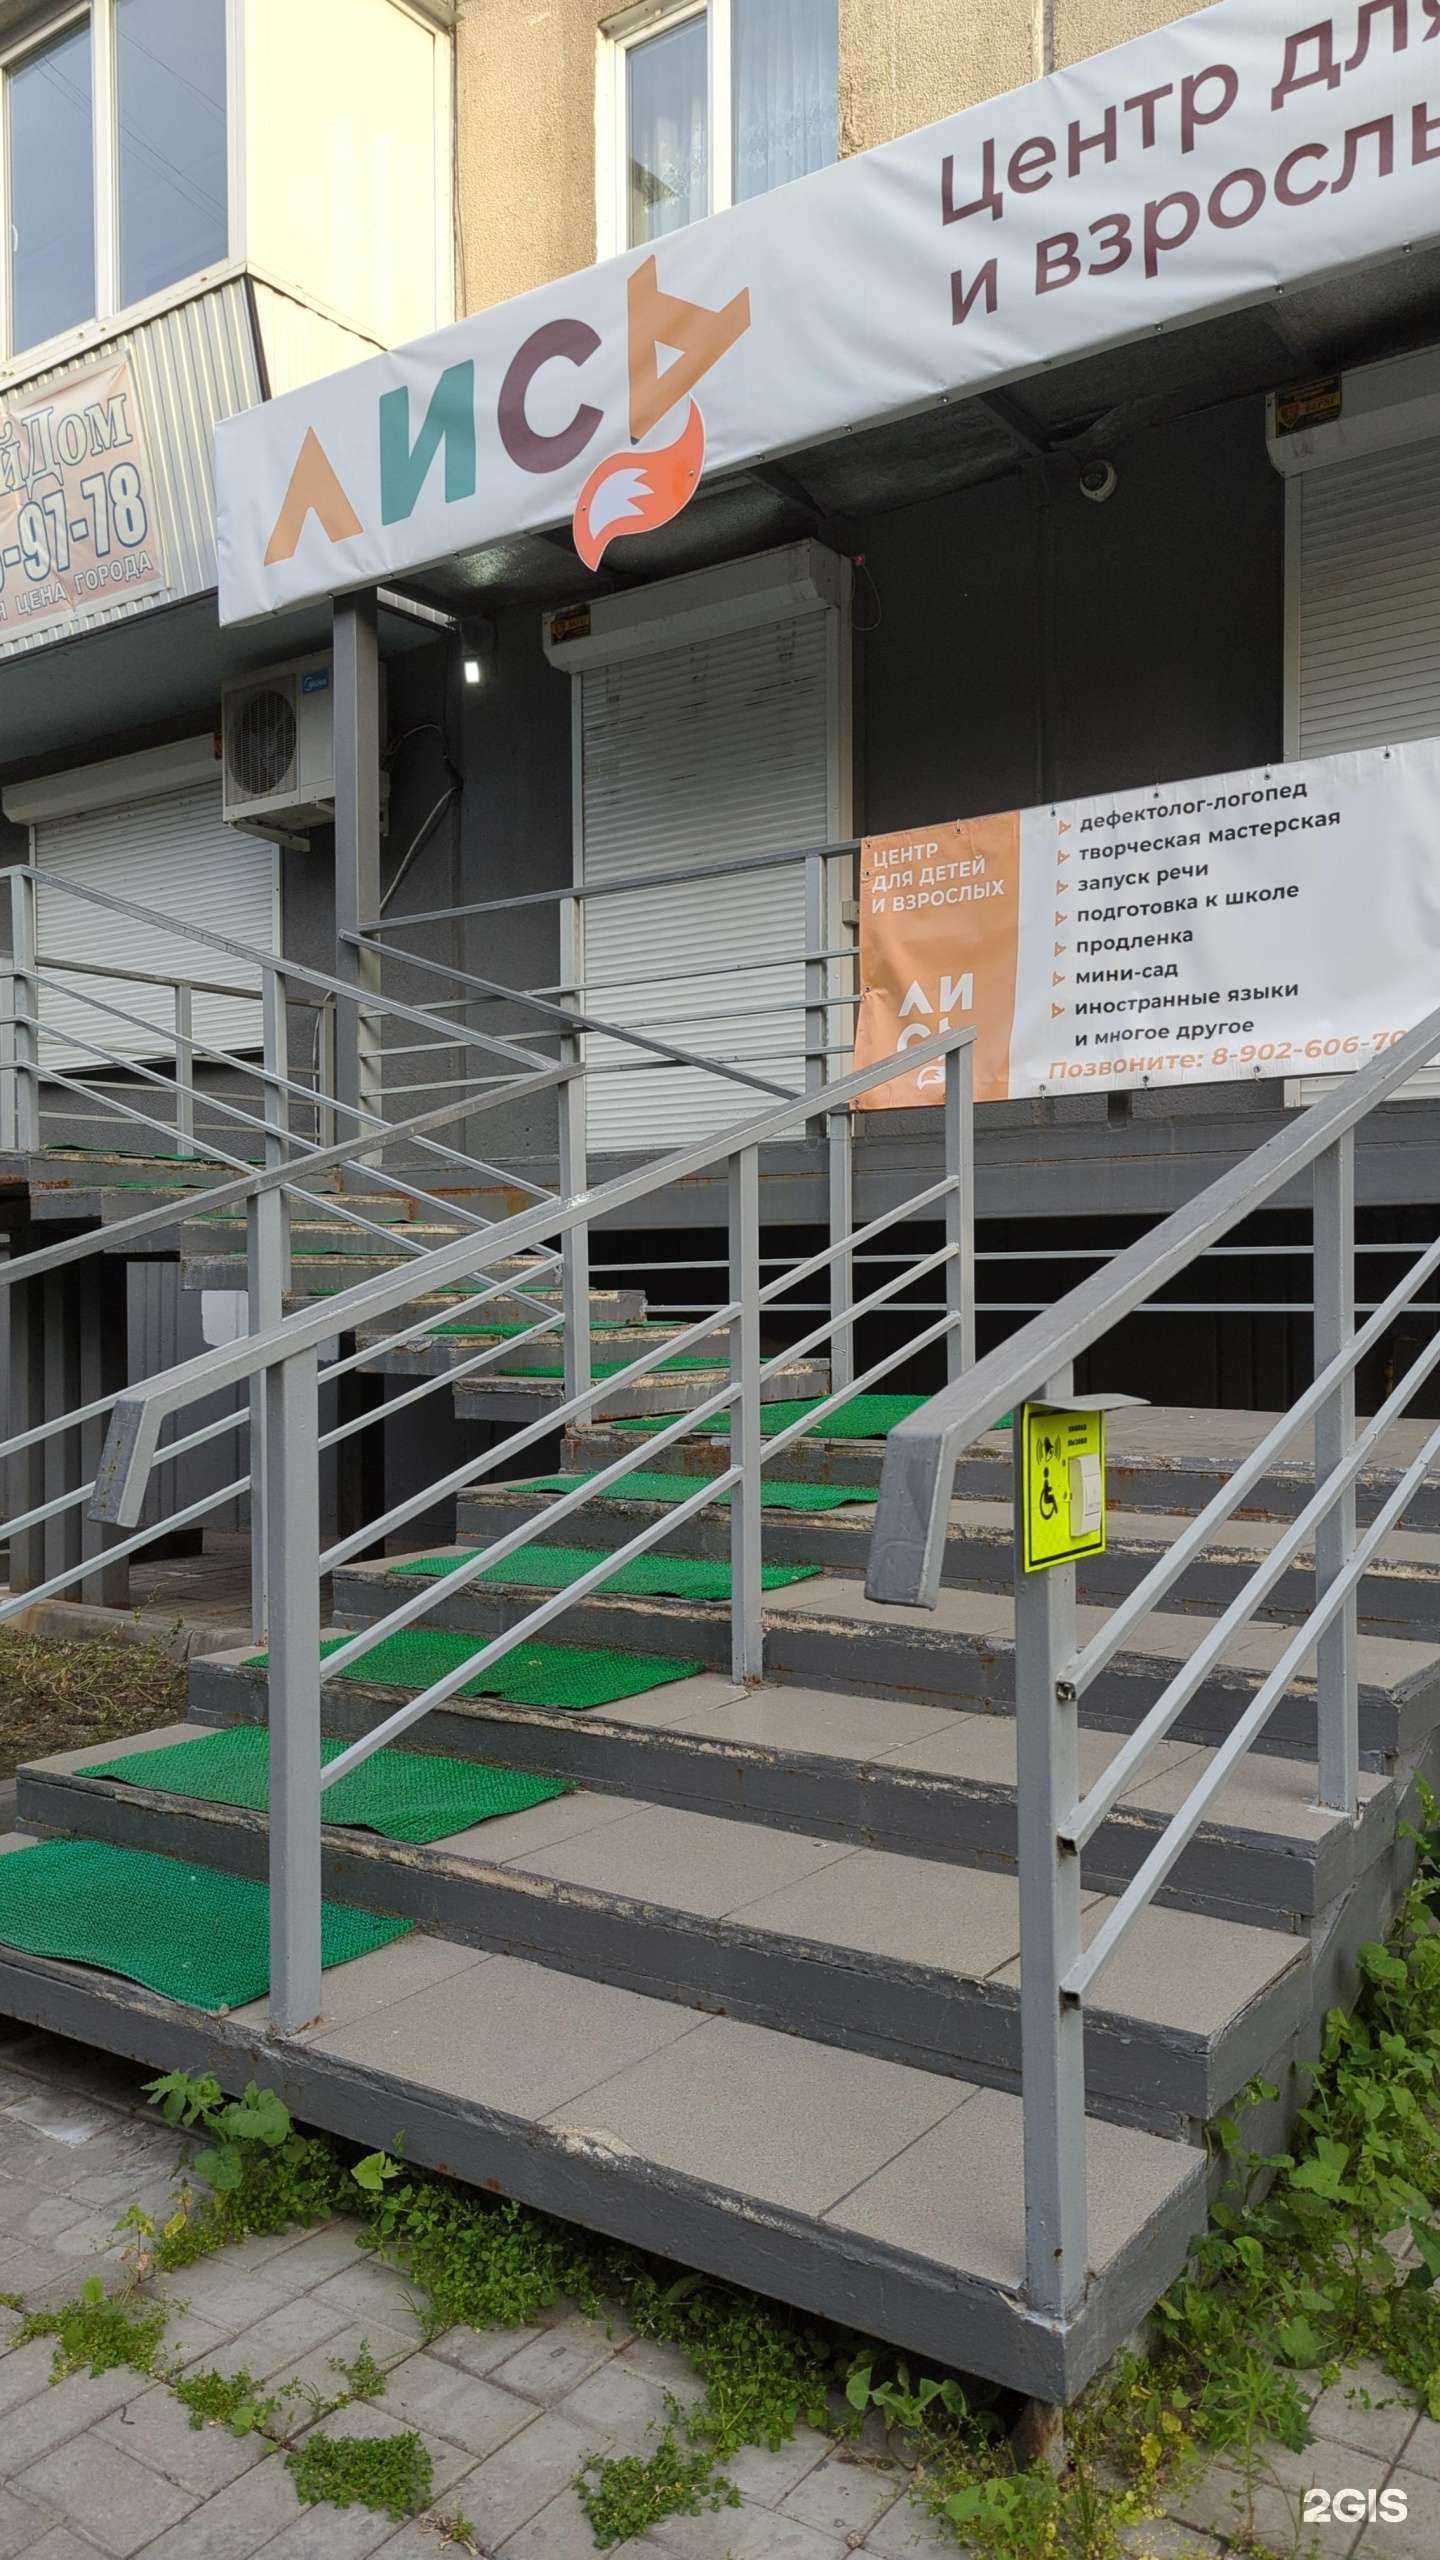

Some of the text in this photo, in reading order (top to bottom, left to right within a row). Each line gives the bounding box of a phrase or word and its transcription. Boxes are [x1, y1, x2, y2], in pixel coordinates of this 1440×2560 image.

[941, 0, 1440, 226] Центр дл
[951, 258, 998, 326] и
[264, 254, 752, 567] ЛИСА
[0, 462, 148, 594] -97-78
[16, 581, 68, 616] ЦЕНА
[74, 551, 153, 595] ГОРОДА
[1080, 782, 1307, 833] дефектолог-логопед
[873, 843, 938, 869] ЦЕНТР
[1079, 810, 1341, 862] творческая мастерская
[871, 854, 986, 894] ДЛЯ ДЕТЕЙ
[1077, 863, 1209, 893] запуск речи
[872, 879, 1005, 914] И ВЗРОСЛЫХ
[1077, 883, 1300, 923] подготовка к школе
[1076, 929, 1194, 956] продленка
[1076, 963, 1179, 984] мини-сад
[1075, 983, 1299, 1016] иностранные языки
[1075, 1018, 1255, 1047] и многое другое
[1048, 1053, 1204, 1079] Позвоните:
